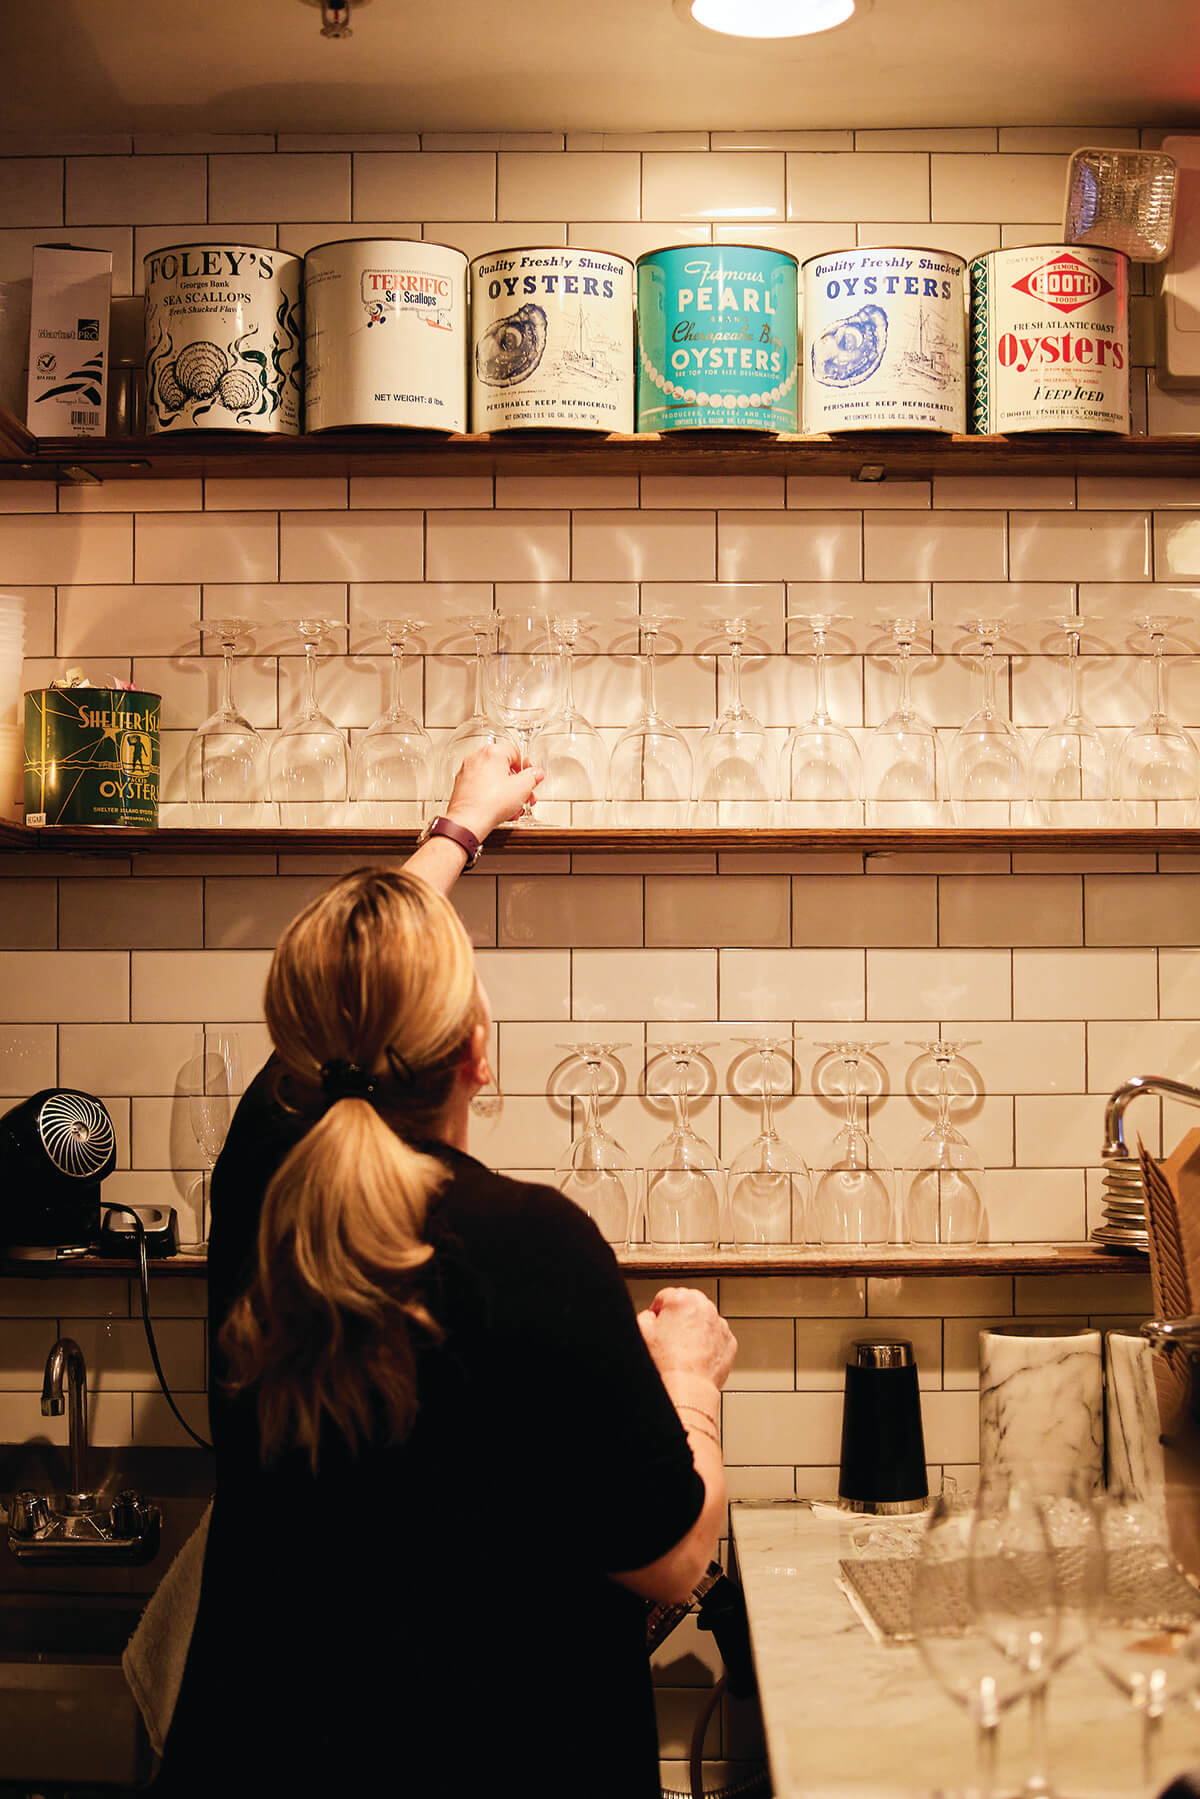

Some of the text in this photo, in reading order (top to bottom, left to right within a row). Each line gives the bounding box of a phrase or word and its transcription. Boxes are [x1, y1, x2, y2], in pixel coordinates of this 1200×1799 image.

[150, 251, 273, 284] FOLEY'S
[479, 257, 624, 278] Quality Freshly Shucked
[684, 261, 765, 286] Famous
[816, 257, 960, 277] Quality Freshly Shucked
[180, 280, 229, 289] Georges Bank
[368, 274, 449, 297] TERRIFIC
[488, 275, 614, 300] OYSTERS
[826, 276, 952, 300] OYSTERS
[1036, 274, 1094, 293] BOOTH
[163, 292, 251, 307] SEA SCALLOPS
[385, 290, 437, 307] Se Scallops
[678, 288, 776, 315] PEARL
[188, 305, 218, 314] Shucked
[220, 305, 243, 313] Flav
[672, 320, 753, 344] Chesapeake
[1014, 321, 1115, 333] FRESH ATLANTIC COAST
[671, 347, 781, 373] OYSTERS
[998, 331, 1124, 373] Oysters
[374, 393, 391, 402] NET
[393, 394, 427, 404] WEIGHT:
[1073, 386, 1104, 402] ICED
[486, 400, 530, 412] PERISHABLE
[562, 400, 617, 411] REFRIGERATED
[824, 401, 870, 412] PERISHABLE
[903, 401, 954, 413] REFRIGERATED
[78, 705, 141, 730] SHELTER
